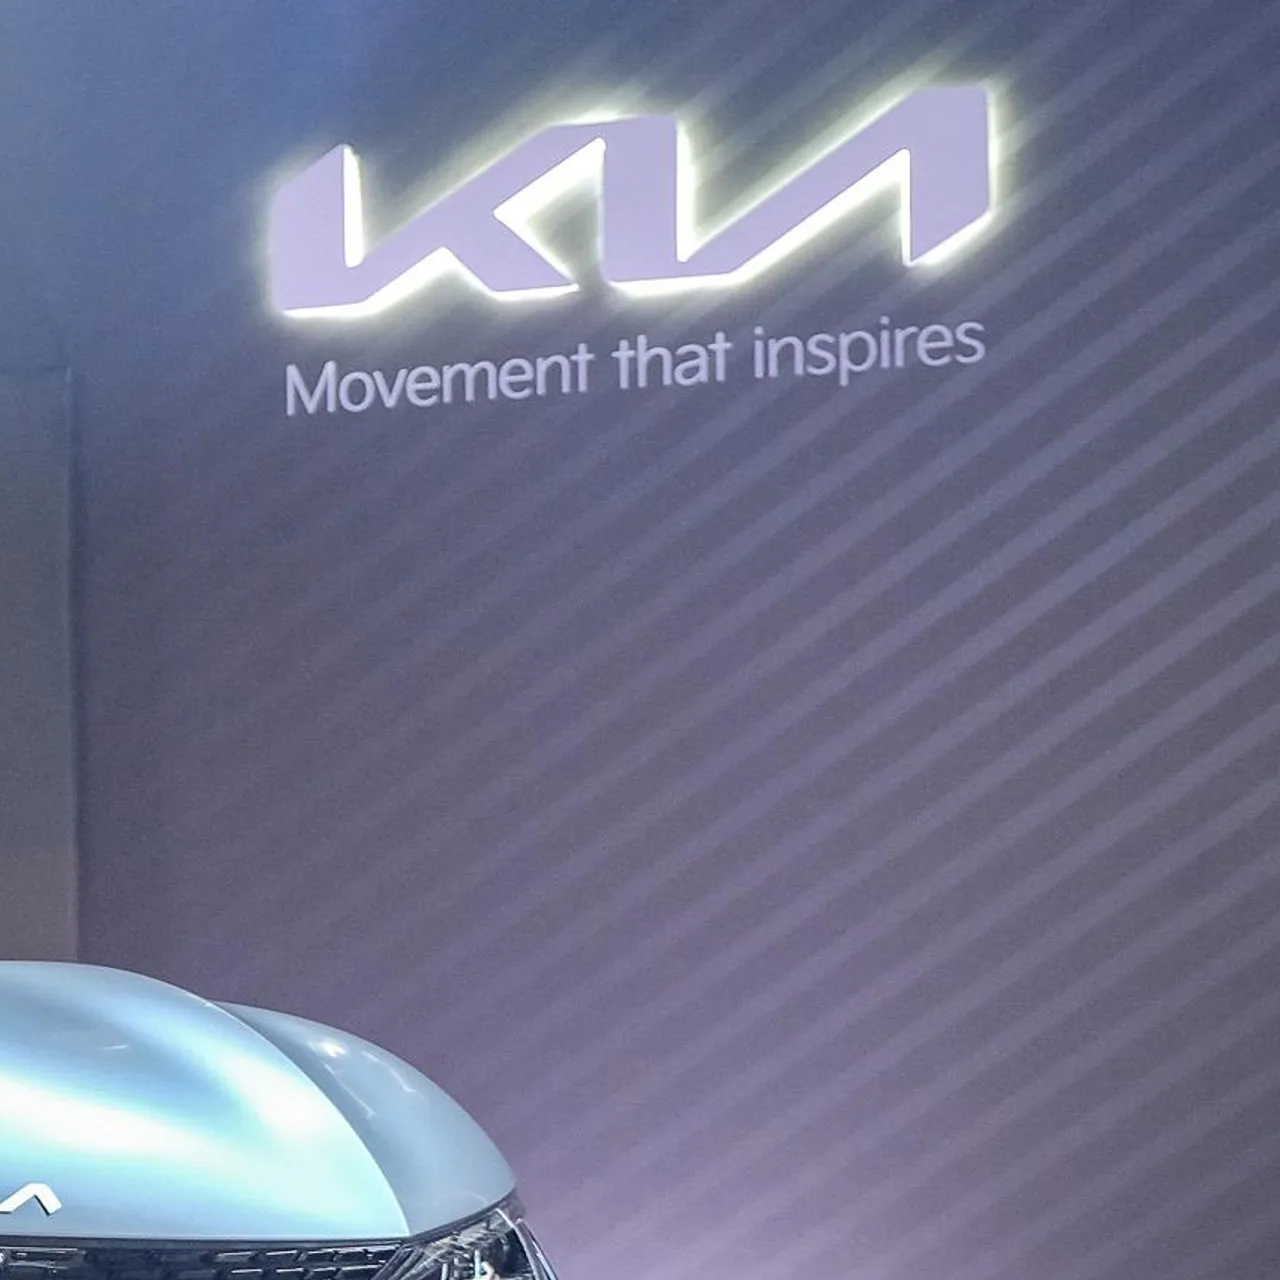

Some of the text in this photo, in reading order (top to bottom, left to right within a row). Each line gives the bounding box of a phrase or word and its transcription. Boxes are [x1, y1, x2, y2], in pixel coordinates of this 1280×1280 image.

[270, 85, 991, 312] KIA
[285, 315, 987, 416] Movement that inspires
